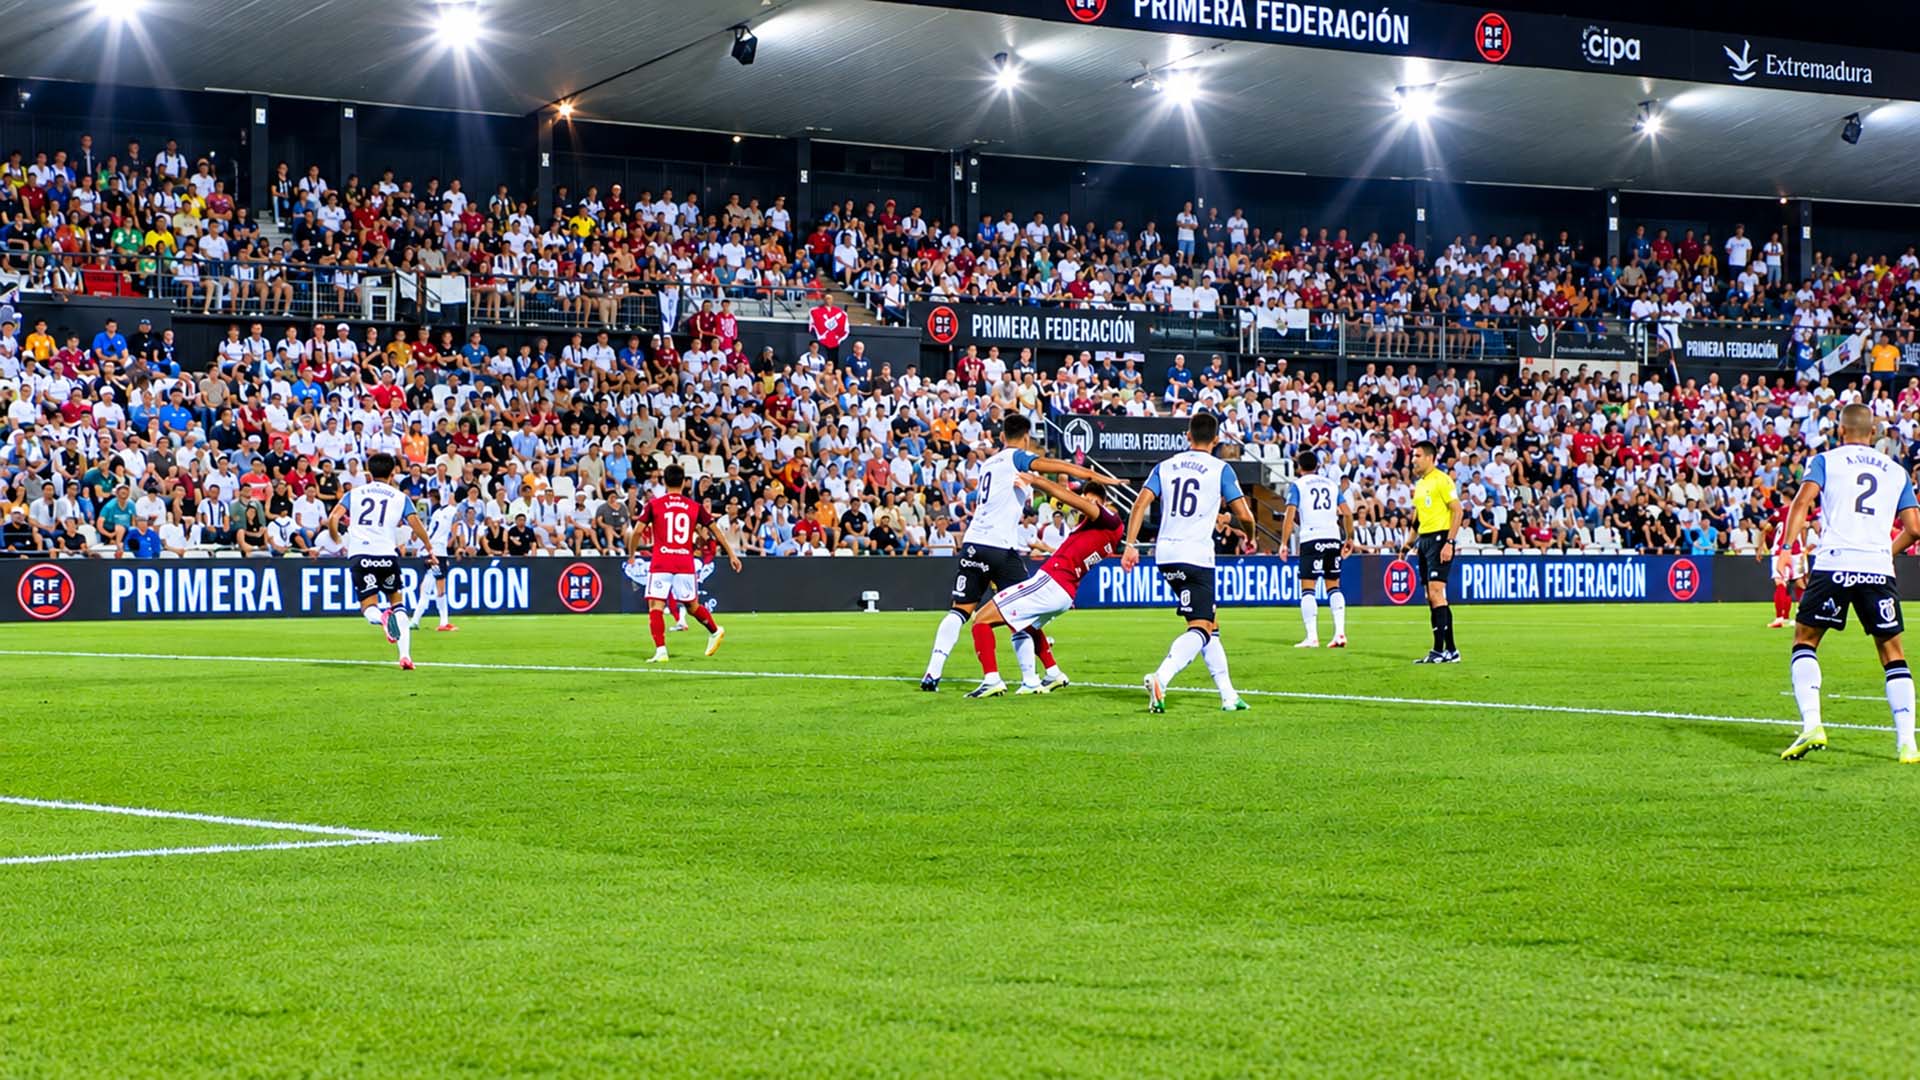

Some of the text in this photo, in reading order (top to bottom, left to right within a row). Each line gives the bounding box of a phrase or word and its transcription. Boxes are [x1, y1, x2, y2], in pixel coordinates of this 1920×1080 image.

[1134, 0, 1410, 45] PRIMERA FEDERACIÓN
[1588, 28, 1641, 65] cipa
[1766, 53, 1873, 84] Extremadura
[972, 313, 1041, 341] PRIMERA
[1045, 314, 1135, 344] FEDERACIÓN
[1686, 339, 1779, 359] PRIMERA FEDERACIÓN
[1099, 432, 1141, 450] PRIMERA
[1170, 476, 1200, 518] 16
[1310, 487, 1332, 511] 23
[1854, 472, 1878, 516] 2
[358, 497, 389, 527] 21
[664, 511, 690, 545] 19
[110, 567, 282, 613] PRIMERA
[1099, 565, 1180, 602] PRIME
[1461, 557, 1646, 600] PRIMERA FEDERACIÓN
